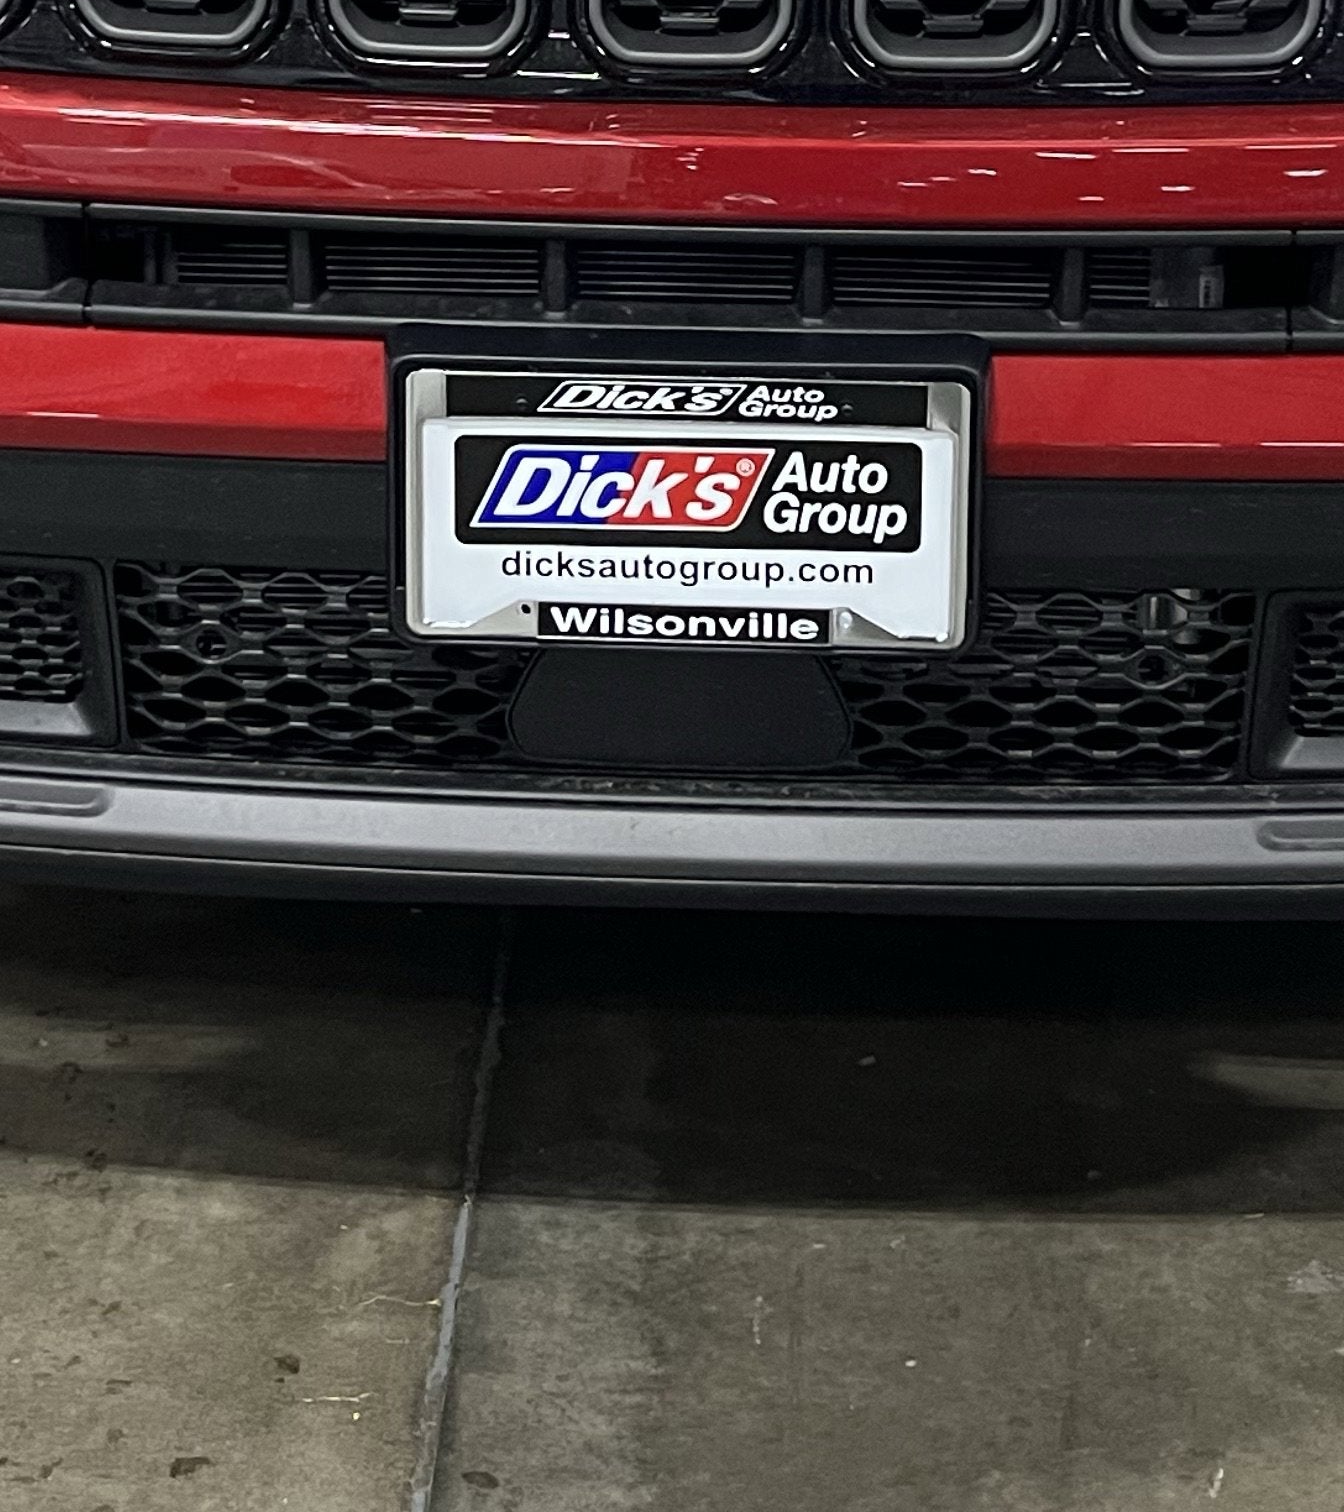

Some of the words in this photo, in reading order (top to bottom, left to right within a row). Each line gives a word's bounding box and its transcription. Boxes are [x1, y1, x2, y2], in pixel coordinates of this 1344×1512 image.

[738, 399, 839, 422] Group
[745, 386, 825, 403] Auto
[775, 452, 889, 494] Auto
[762, 493, 909, 544] Group
[501, 551, 874, 588] dicksautogroup.com
[549, 606, 821, 641] Wilsonville
